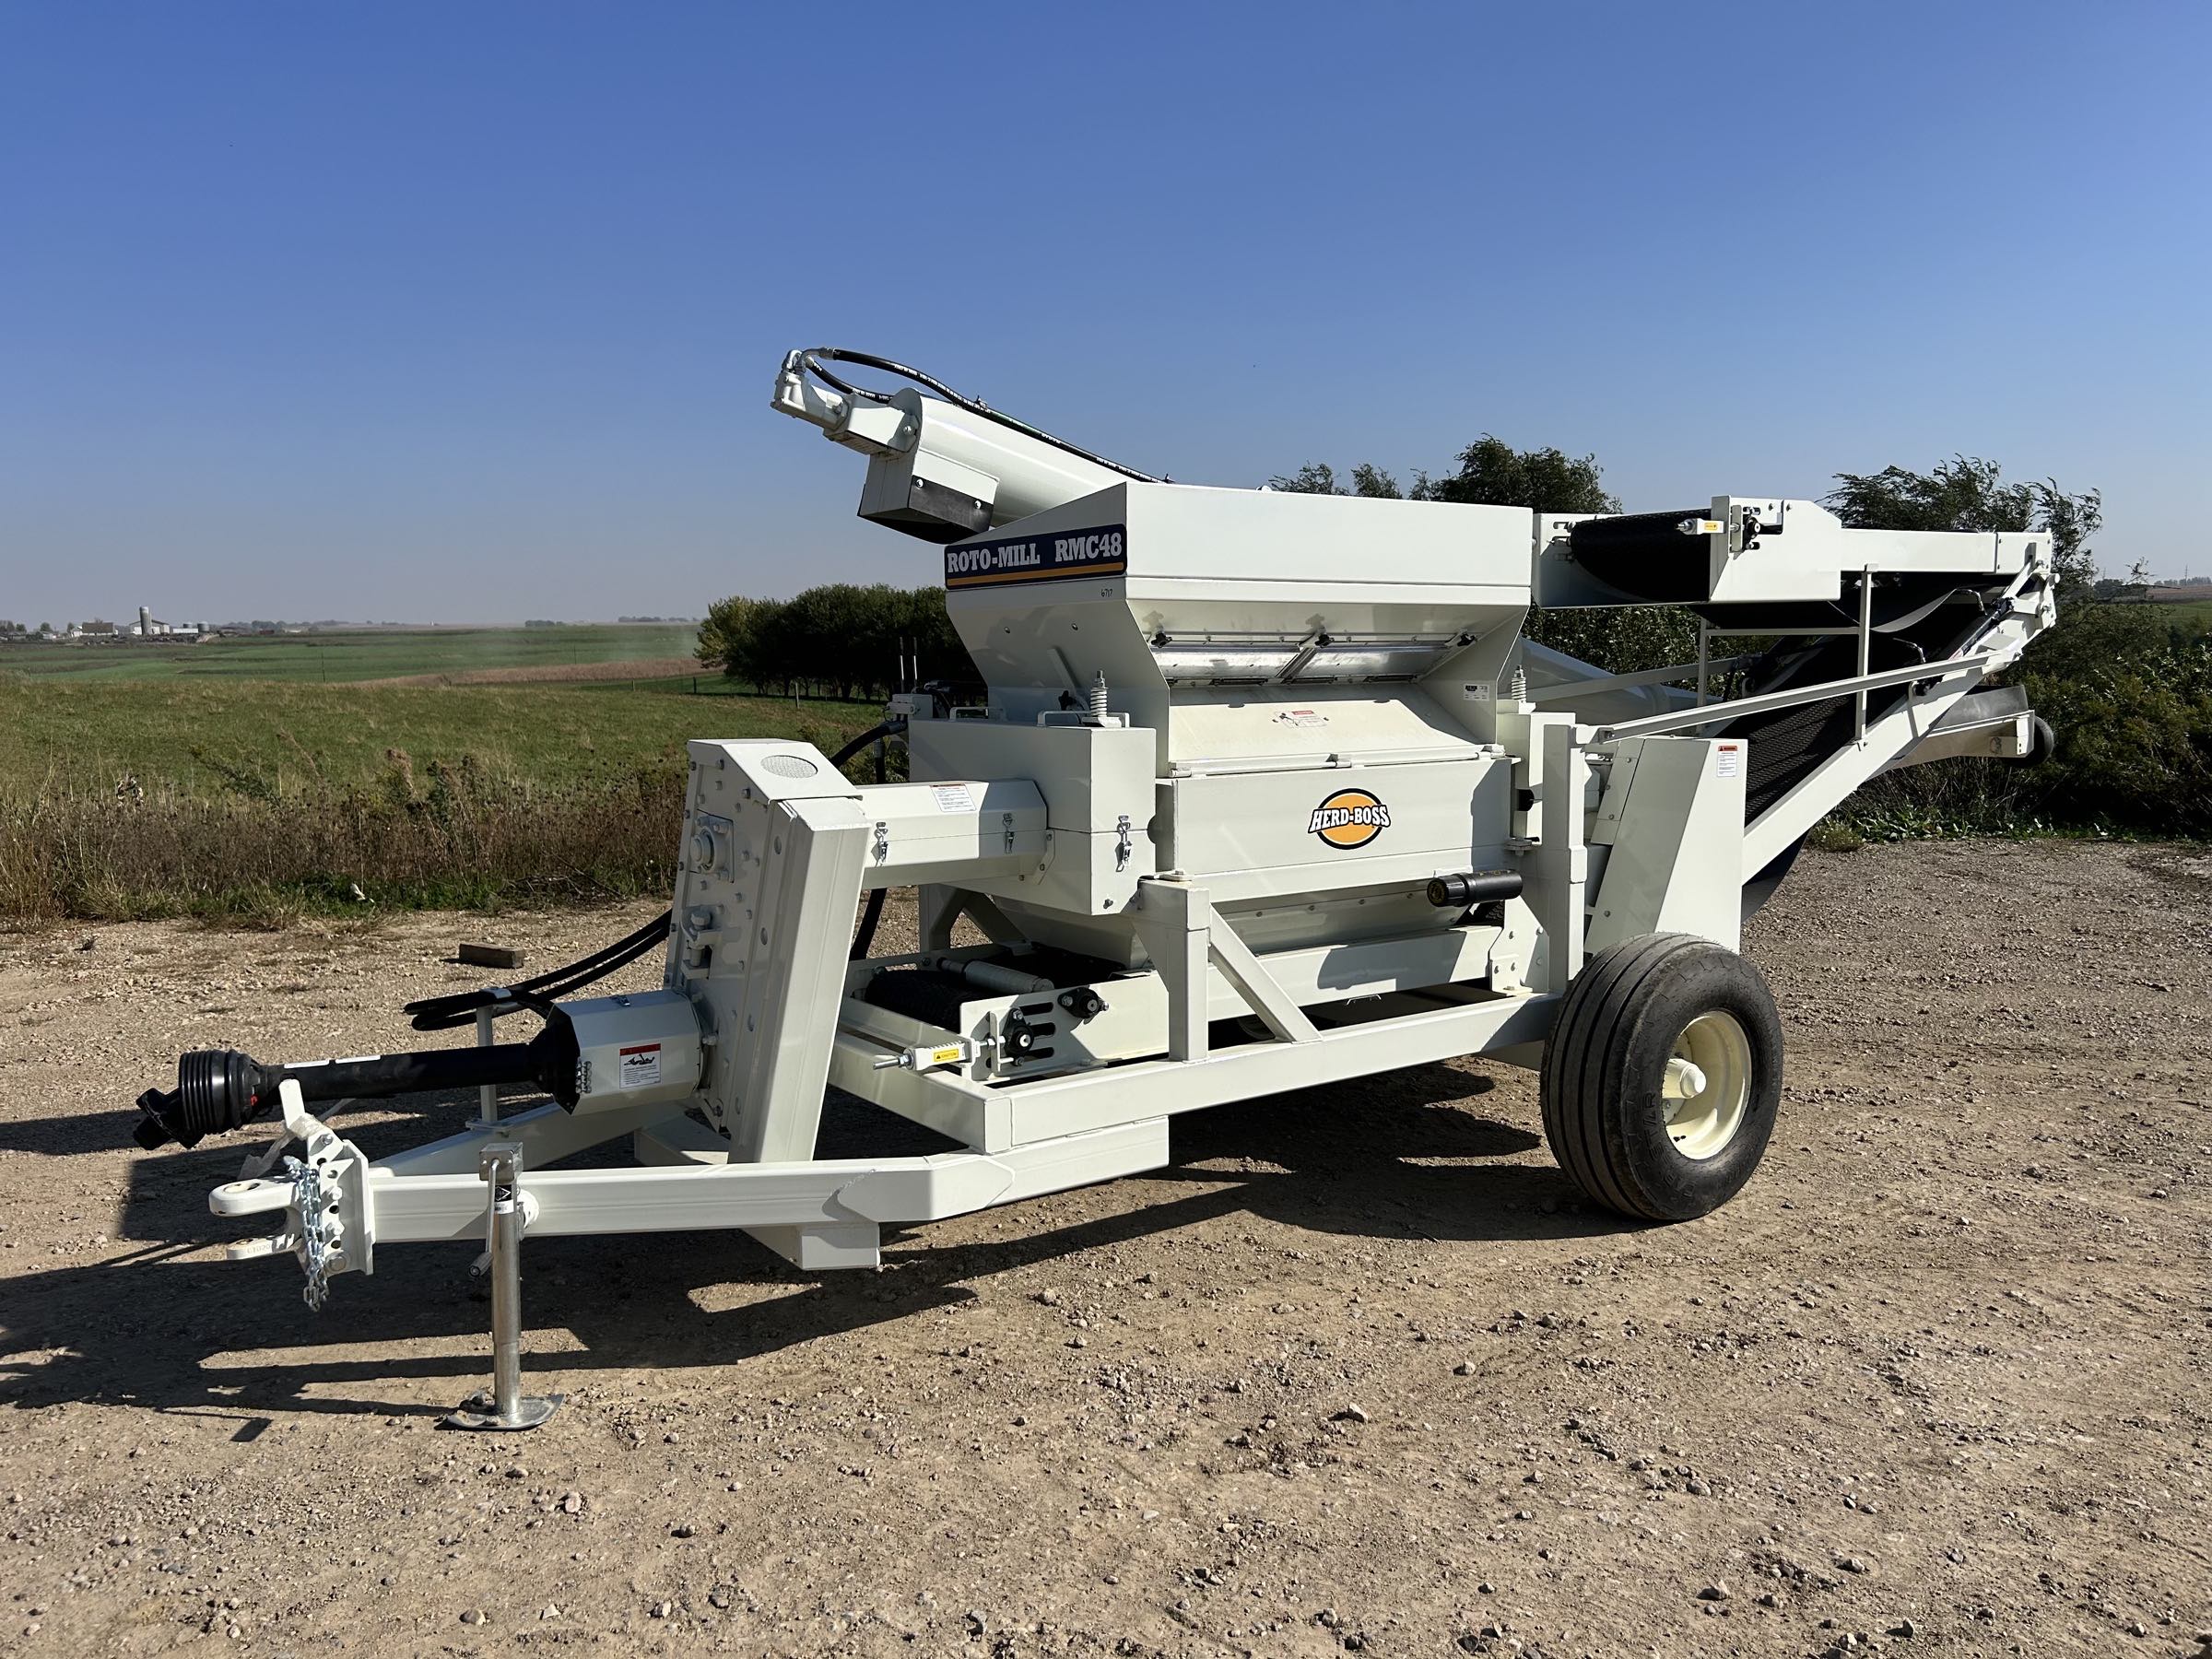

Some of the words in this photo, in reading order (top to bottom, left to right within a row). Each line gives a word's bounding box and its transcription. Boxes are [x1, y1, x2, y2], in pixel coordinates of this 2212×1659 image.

[947, 543, 1041, 573] ROTO-MILL
[1054, 532, 1123, 562] RMC48
[1309, 805, 1391, 833] HERD-BOSS
